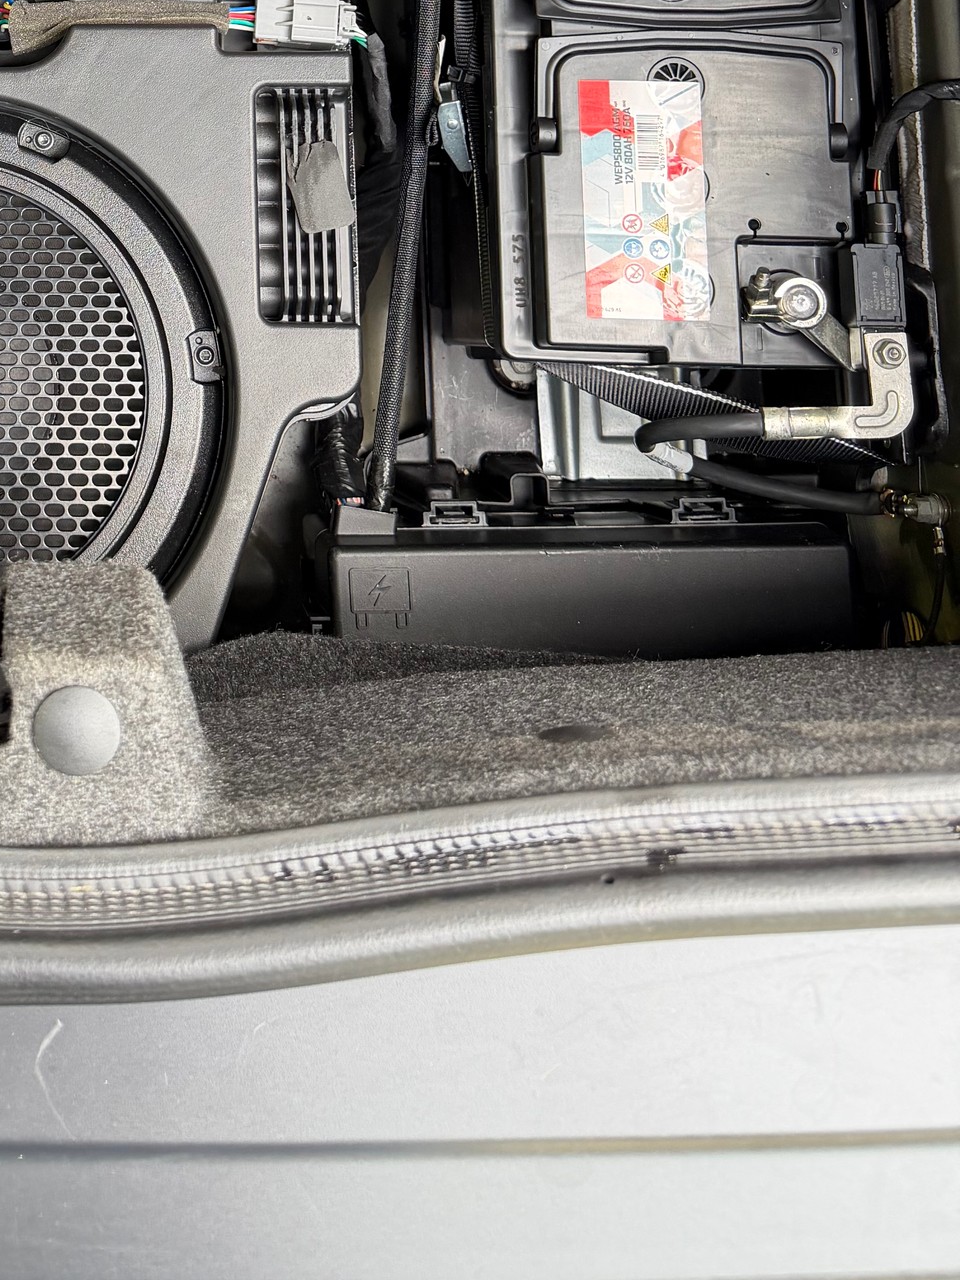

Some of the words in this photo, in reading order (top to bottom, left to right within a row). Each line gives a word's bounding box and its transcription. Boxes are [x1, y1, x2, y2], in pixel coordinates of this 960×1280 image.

[612, 108, 621, 132] AGM
[622, 107, 632, 133] 760A
[613, 135, 623, 185] WEP5800
[623, 136, 633, 165] 80AH
[624, 166, 633, 184] 12V
[511, 234, 526, 265] 575
